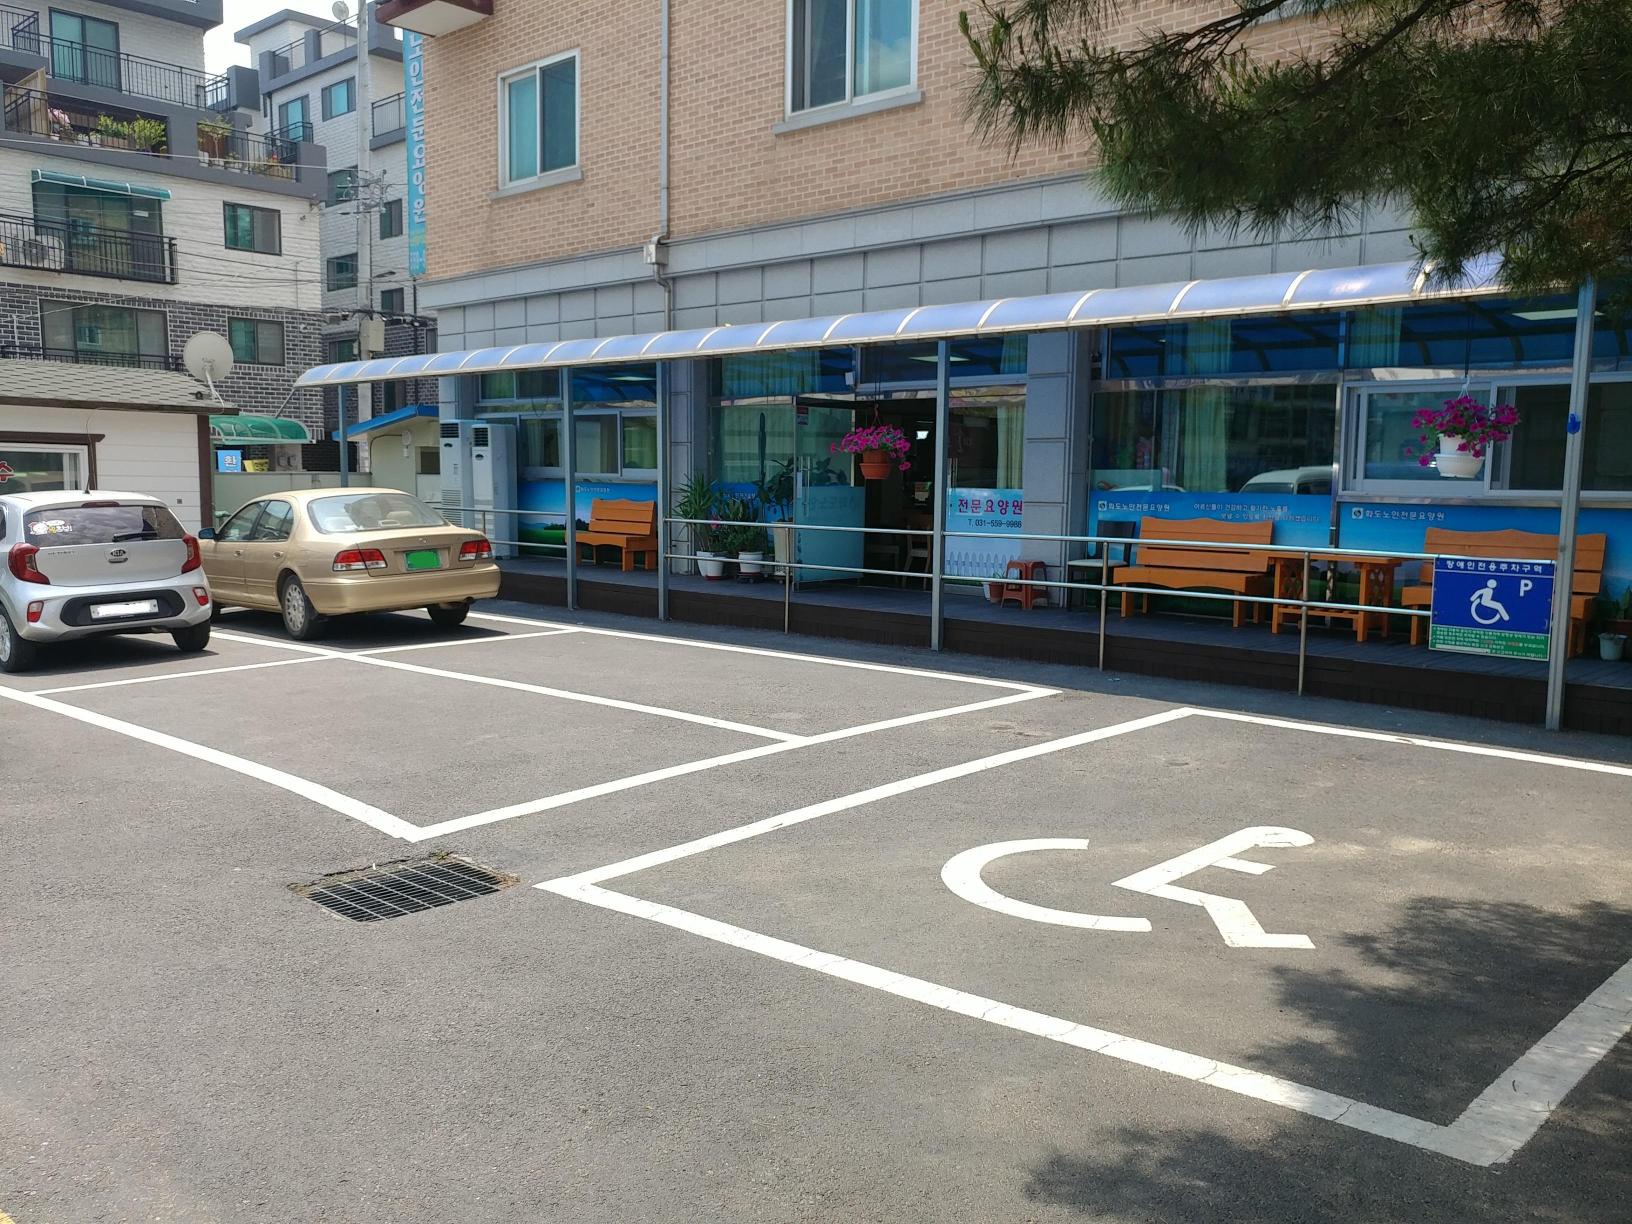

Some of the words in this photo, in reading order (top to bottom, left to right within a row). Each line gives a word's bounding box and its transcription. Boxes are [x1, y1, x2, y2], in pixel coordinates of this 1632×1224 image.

[957, 498, 1023, 515] 전문요양원
[1446, 560, 1543, 574] 장애인전용주차구역
[1519, 579, 1532, 597] P
